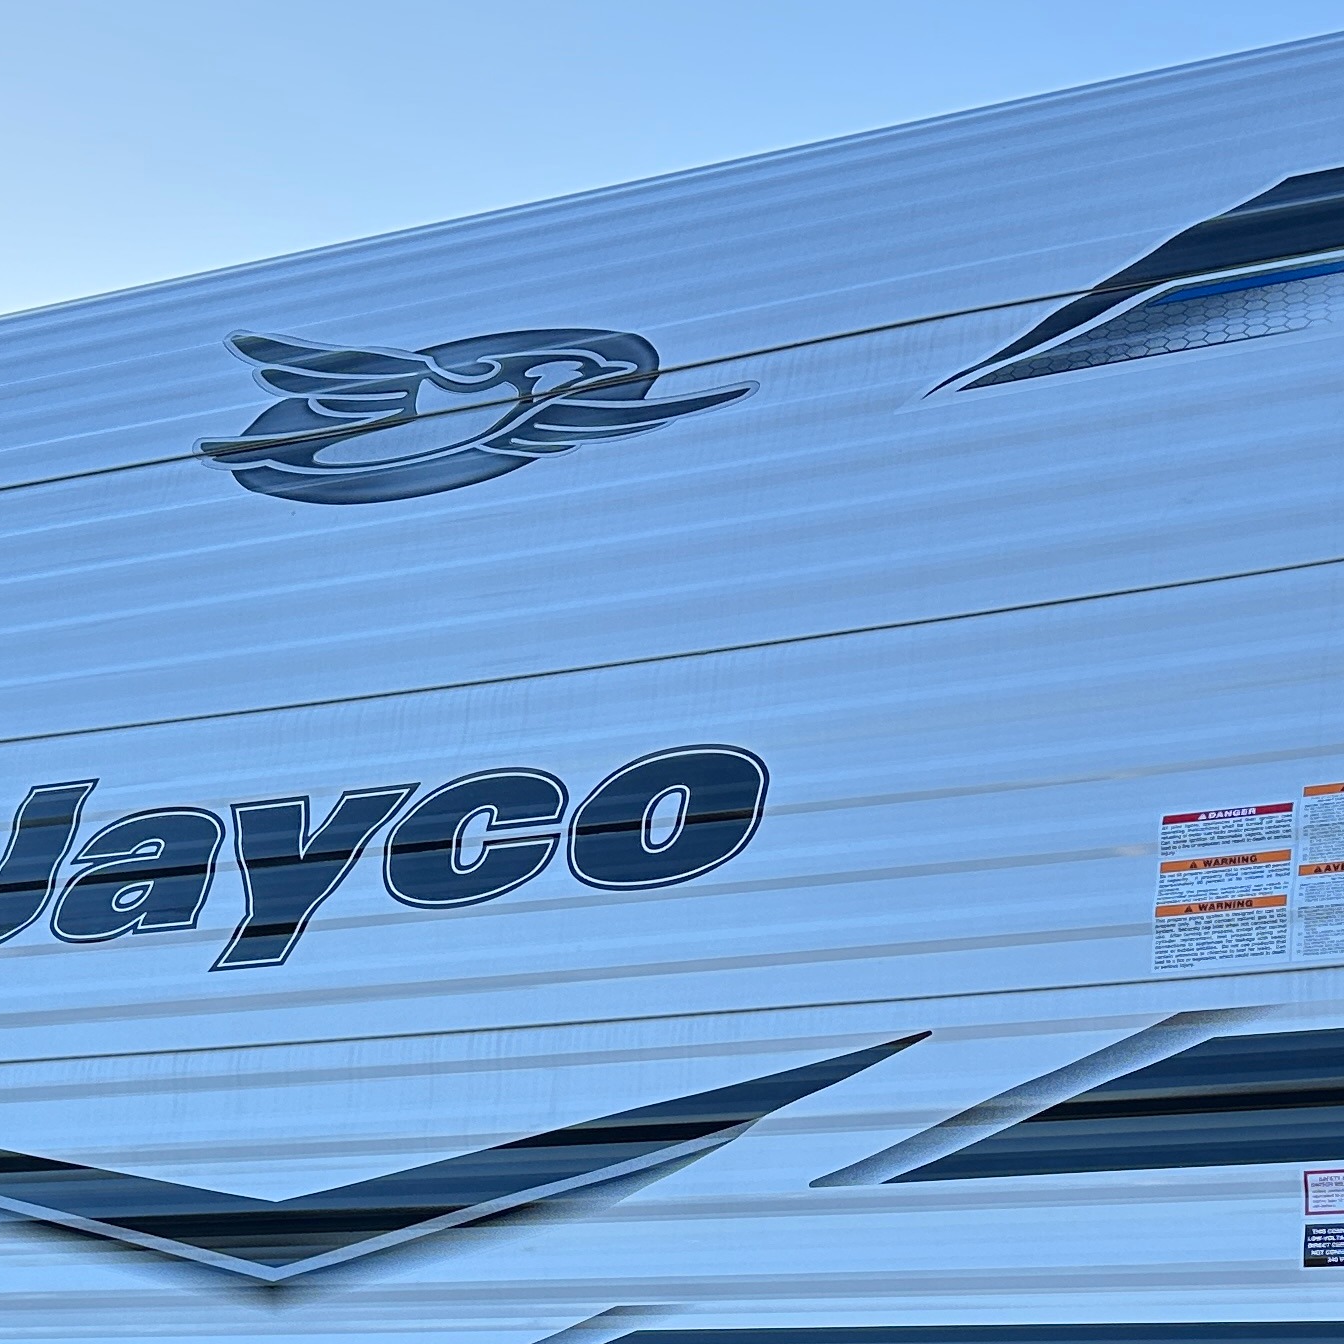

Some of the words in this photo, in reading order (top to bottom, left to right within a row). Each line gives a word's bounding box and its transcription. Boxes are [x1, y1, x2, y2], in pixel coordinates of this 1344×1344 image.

[1208, 807, 1257, 819] DANGER
[1203, 854, 1258, 868] WARNING
[1198, 899, 1253, 912] WARNING
